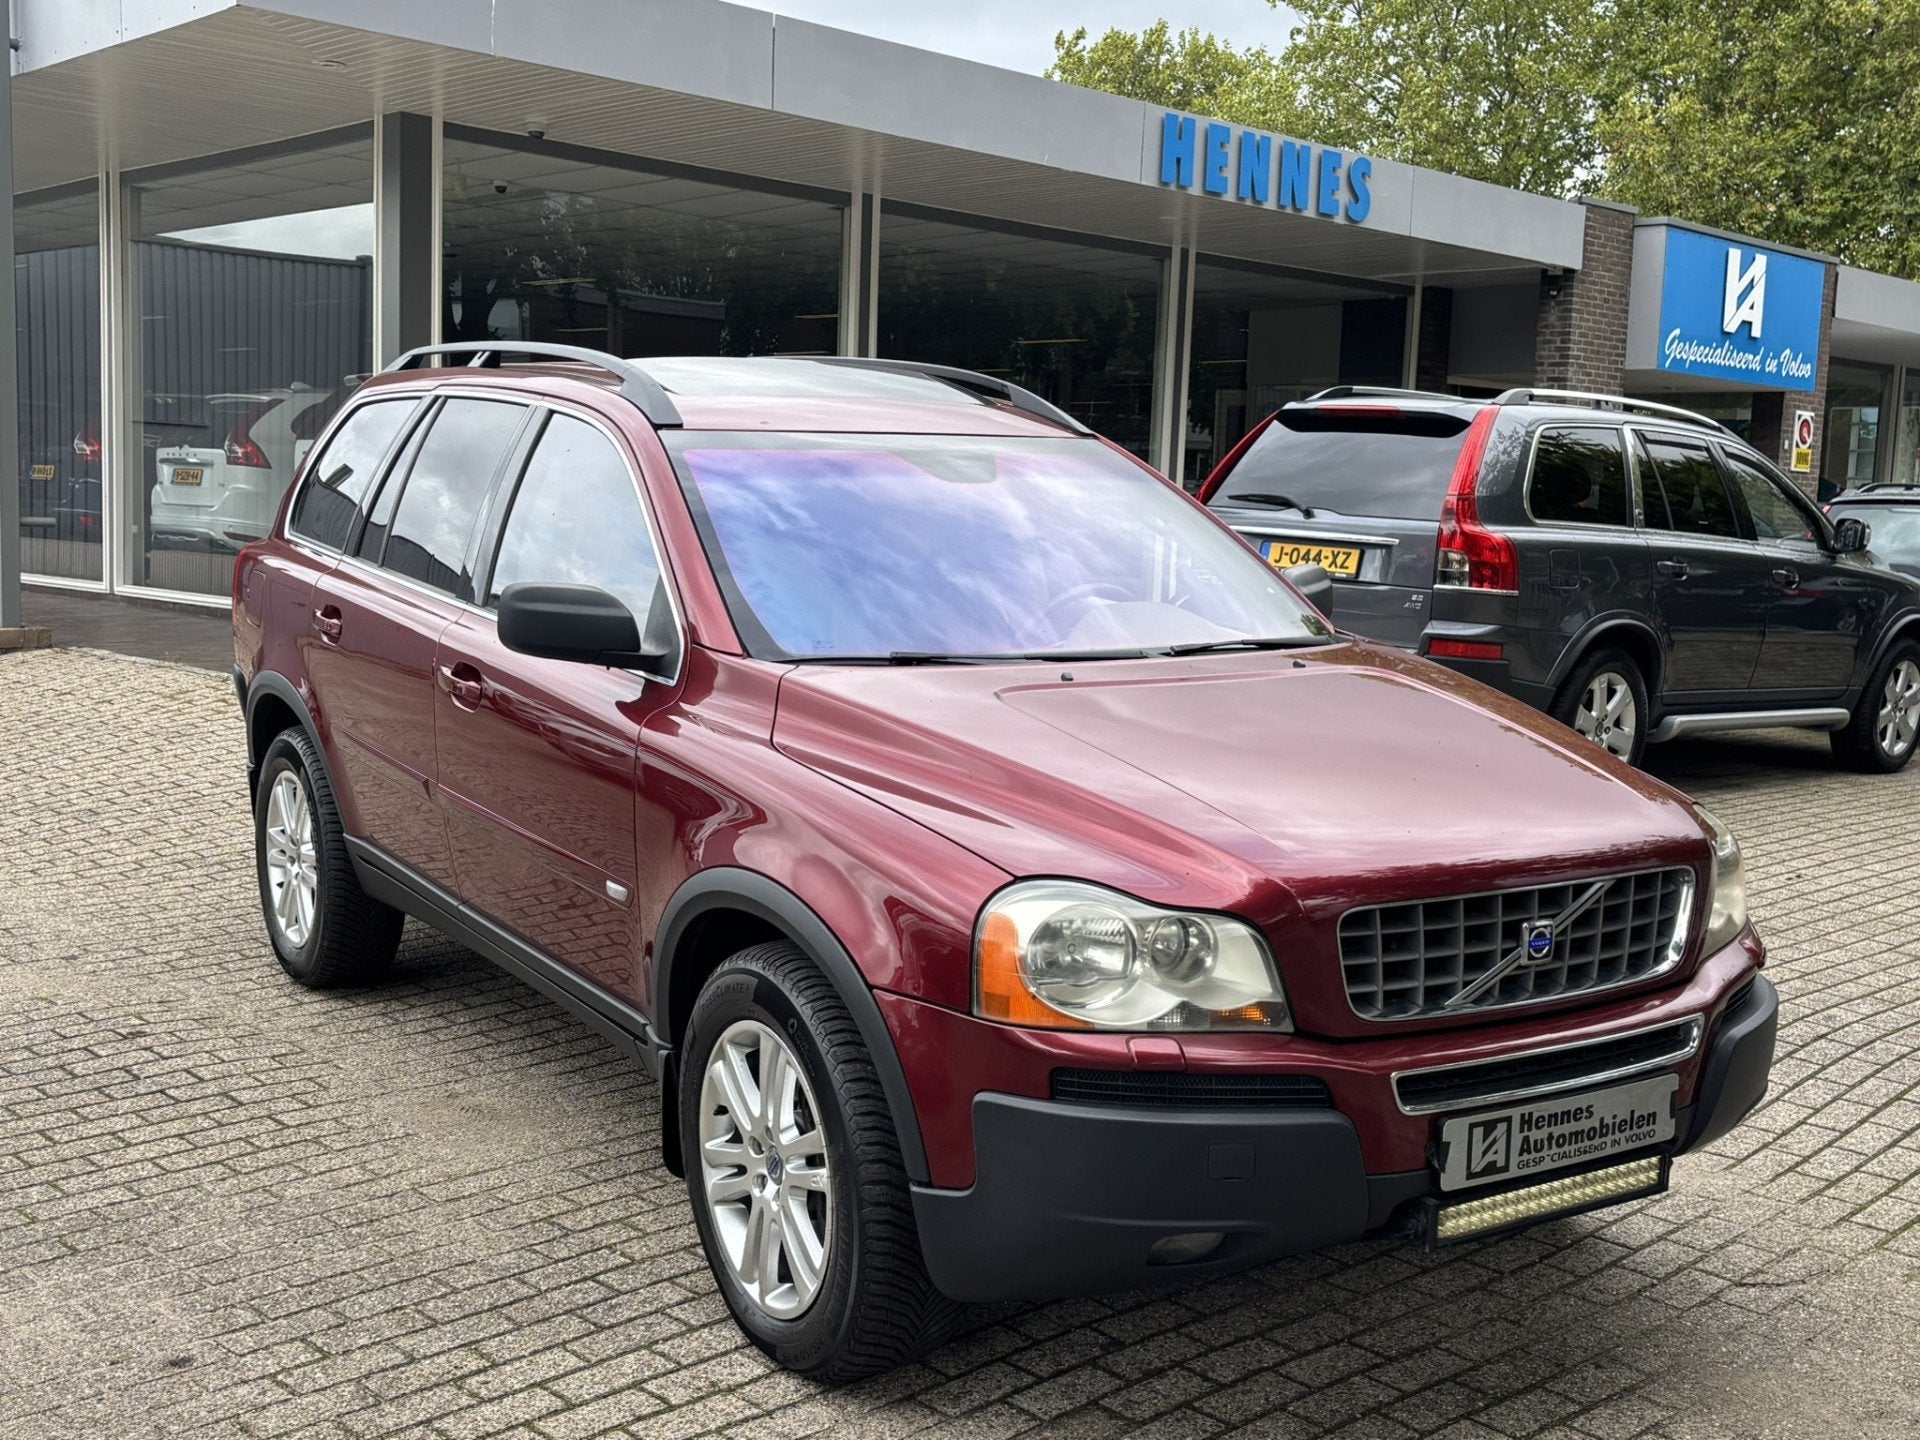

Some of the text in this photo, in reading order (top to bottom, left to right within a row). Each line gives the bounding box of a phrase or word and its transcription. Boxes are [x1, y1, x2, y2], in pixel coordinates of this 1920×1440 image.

[1161, 112, 1372, 222] HENNES
[1665, 328, 1812, 378] Gespecialiseerd in Volvo
[1274, 546, 1352, 570] J-044-XZ
[1518, 1109, 1657, 1157] Automobielen
[1519, 1104, 1594, 1133] Hennes
[1610, 1138, 1621, 1149] IN
[1624, 1128, 1656, 1145] VOLVO
